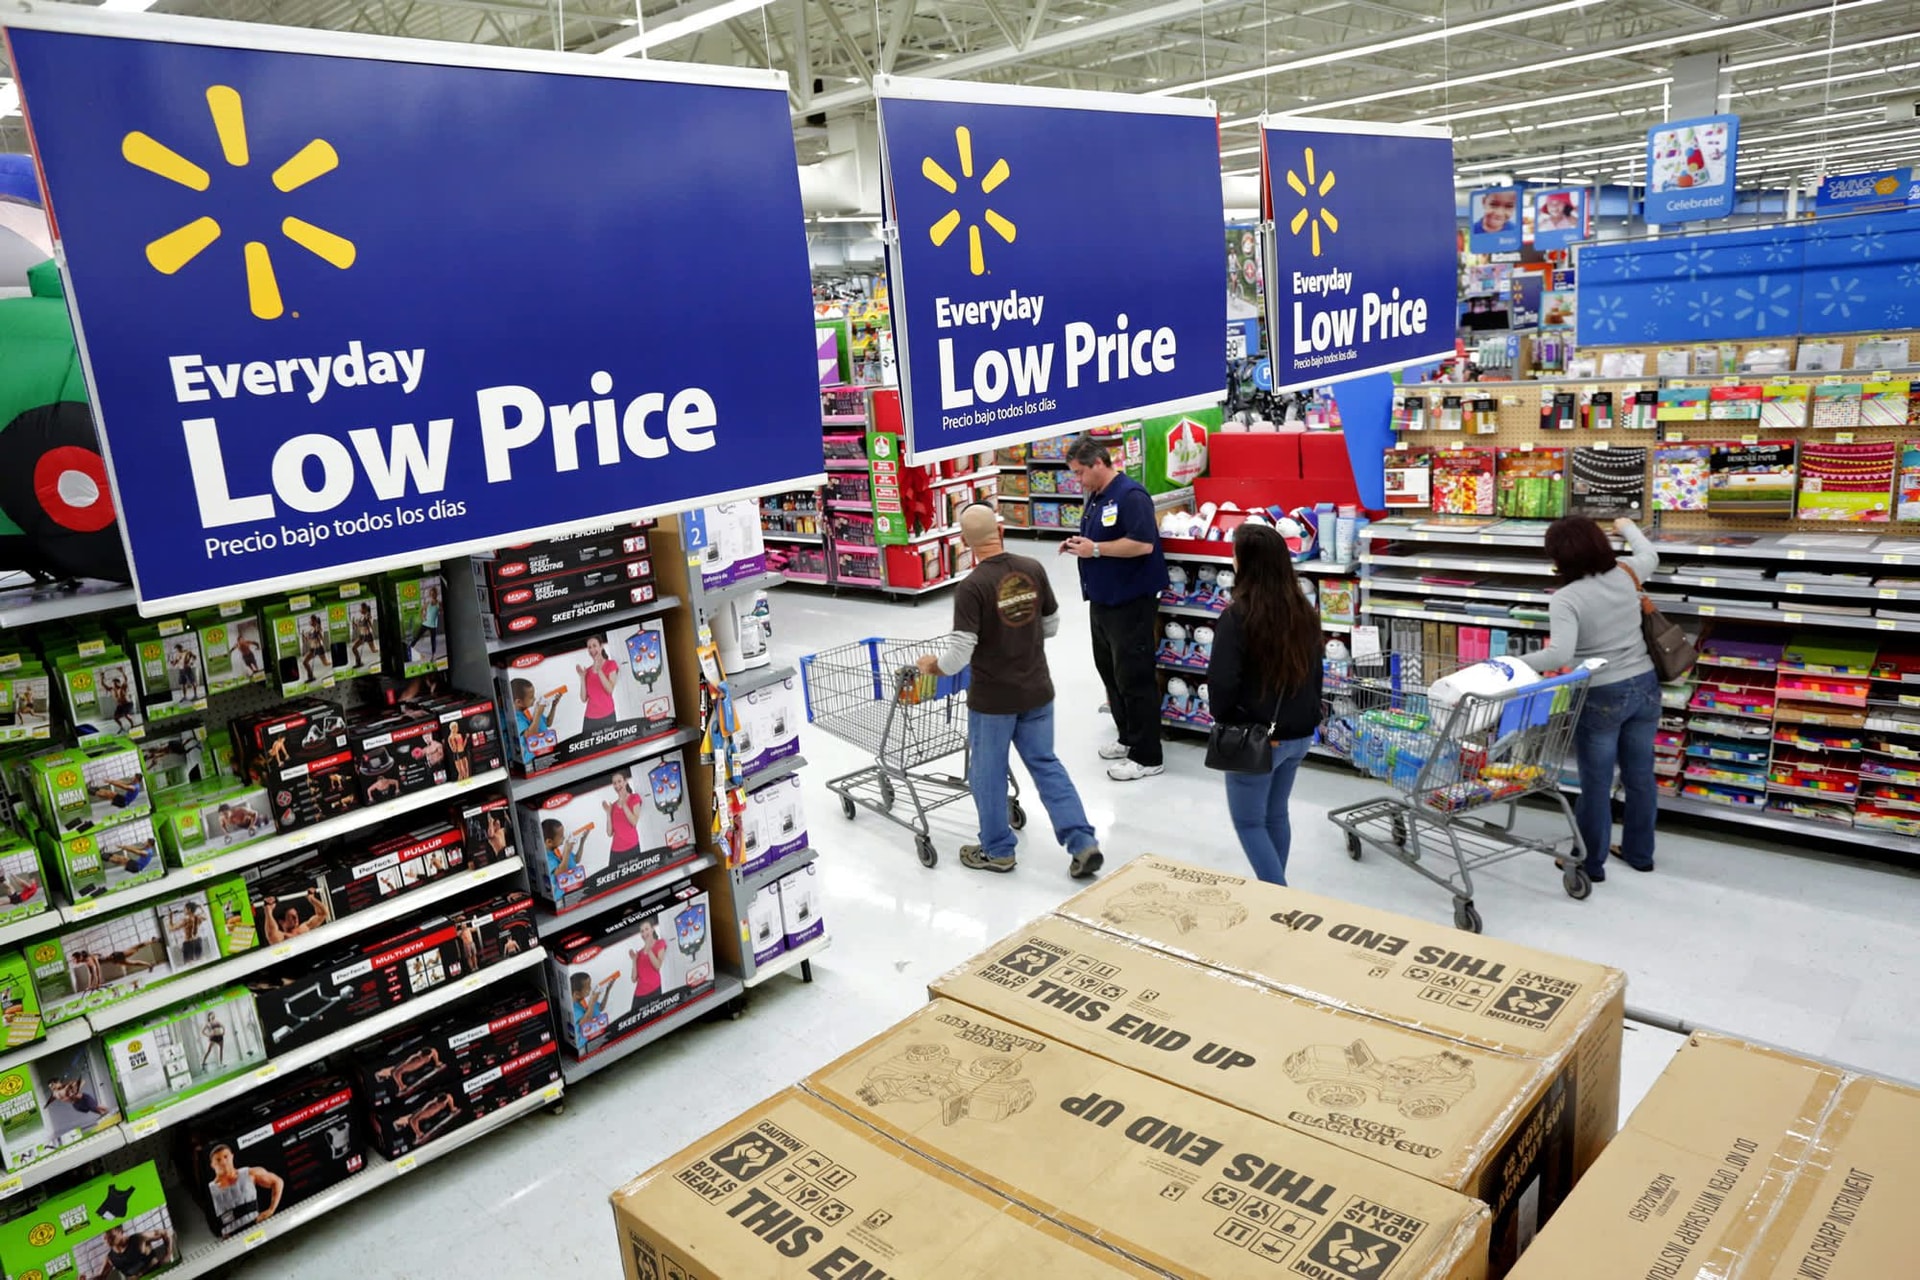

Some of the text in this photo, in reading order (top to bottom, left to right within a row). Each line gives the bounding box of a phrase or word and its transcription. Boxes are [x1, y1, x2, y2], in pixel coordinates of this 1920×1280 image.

[1828, 176, 1877, 193] SAVINGS
[1830, 188, 1873, 199] CATCHER
[1666, 195, 1724, 212] Celebrate!
[1293, 267, 1352, 298] Everyday
[935, 289, 1044, 331] Everyday
[1293, 287, 1428, 355] Low Price
[1508, 336, 1517, 346] G
[1508, 347, 1515, 357] 6
[169, 340, 425, 403] Everyday
[938, 313, 1176, 410] Low Price
[1294, 359, 1311, 370] Precio
[1311, 356, 1323, 368] bajo
[1323, 353, 1338, 363] todos
[1338, 352, 1346, 361] los
[942, 397, 1056, 431] Precio bajo todos los días
[182, 370, 717, 528] Low Price
[204, 498, 466, 559] Precio bajo todos los días
[690, 528, 701, 546] 2
[529, 558, 549, 568] SKEET
[530, 561, 564, 575] SHOOTING
[534, 584, 555, 595] SKEET
[535, 587, 569, 601] SHOOTING
[552, 600, 615, 623] SKEET SHOOTING
[568, 725, 638, 753] SKEET SHOOTING
[403, 838, 443, 858] PULLUP
[596, 854, 661, 886] SKEET SHOOTING
[605, 904, 665, 934] SKEET SHOOTING
[1270, 909, 1324, 933] UP
[375, 941, 425, 965] MULTI-GYM
[1029, 937, 1072, 957] CAUTION
[1327, 923, 1409, 957] END
[978, 968, 1021, 990] HEAVY
[986, 963, 1030, 987] BOX IS
[1413, 945, 1507, 983] THIS
[1515, 977, 1573, 997] BOX IS
[1520, 971, 1577, 990] HEAVY
[492, 1009, 533, 1030] RIP DECK
[617, 992, 681, 1031] SKEET SHOOTING
[1026, 980, 1111, 1022] THIS
[1106, 1013, 1192, 1052] END
[1192, 1042, 1257, 1071] UP
[1486, 1009, 1546, 1030] CAUTION
[130, 1055, 148, 1067] GYM
[519, 1050, 542, 1064] DECK
[1060, 1093, 1125, 1128] UP
[1327, 1112, 1406, 1138] 12 VOLT
[756, 1121, 805, 1152] CAUTION
[1124, 1115, 1224, 1168] END
[1288, 1111, 1443, 1159] BLACKOUT SUV
[1517, 1103, 1546, 1157] VOLT
[678, 1169, 725, 1201] HEAVY
[691, 1161, 738, 1194] BOX IS
[1222, 1153, 1338, 1216] THIS
[1674, 1137, 1759, 1246] DO NOT OPEN WITH SHARP
[726, 1187, 824, 1258] THIS
[1343, 1208, 1415, 1244] BOX IS
[1352, 1200, 1422, 1233] HEAVY
[1796, 1167, 1875, 1280] WITH SHARP INSTRUMENT
